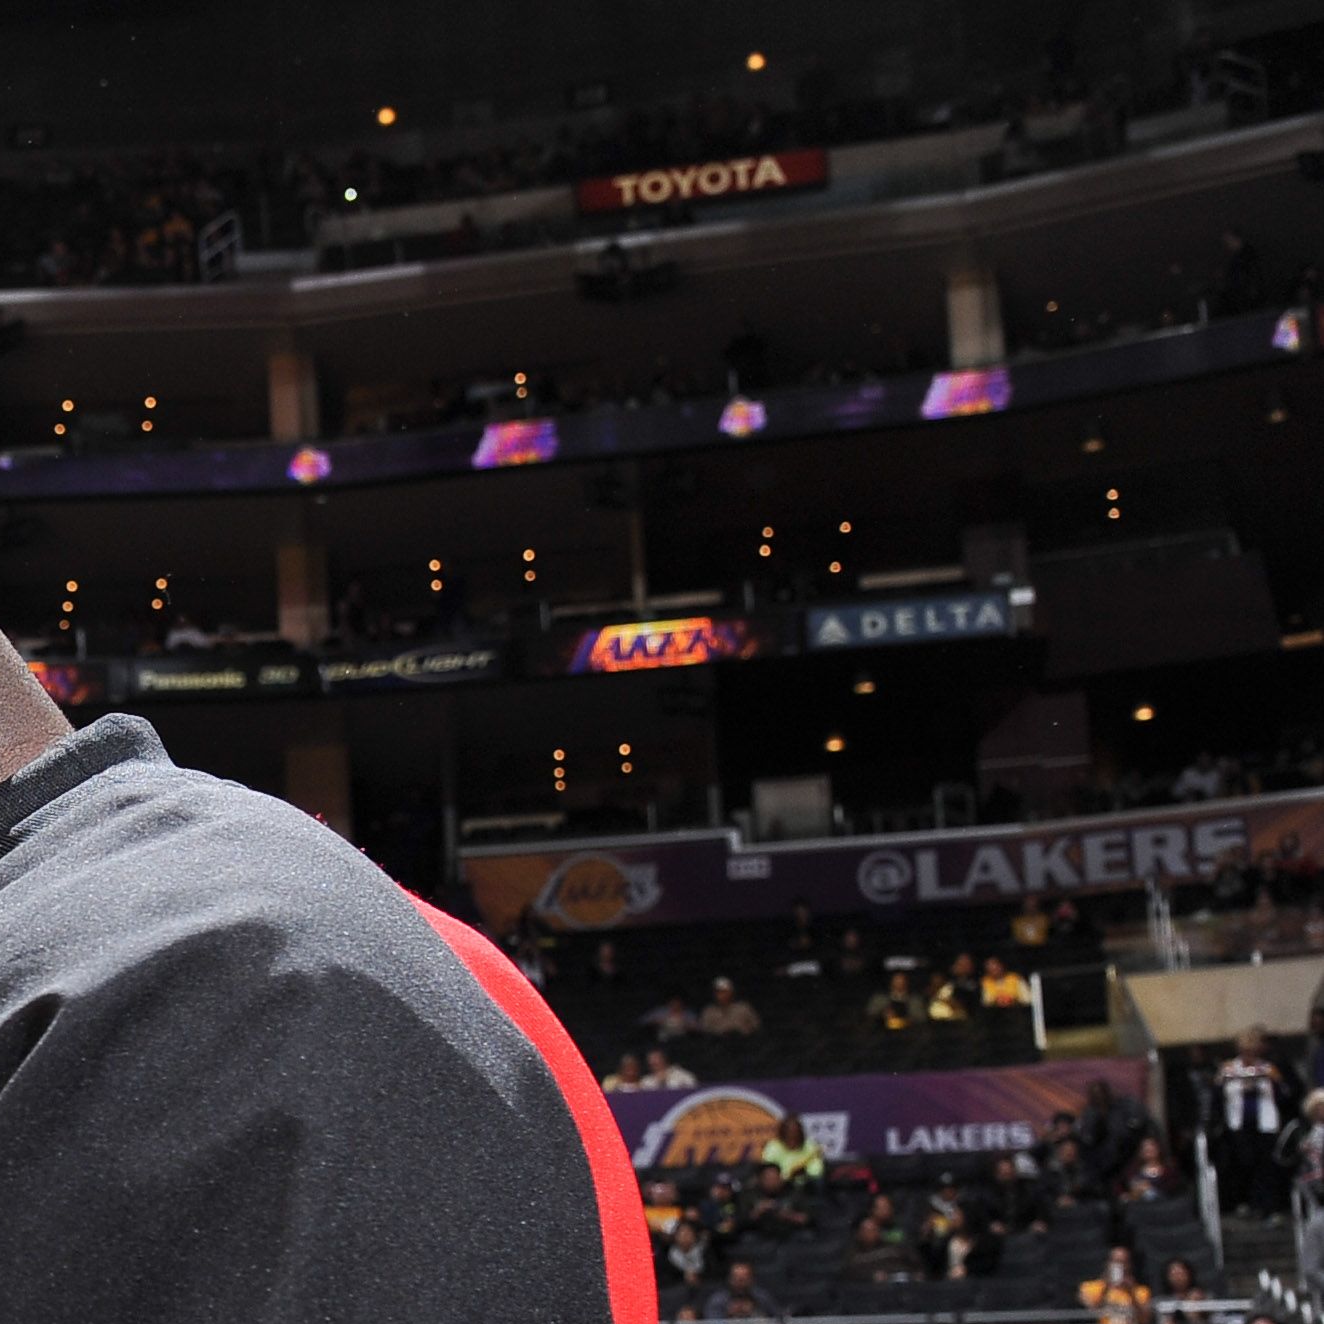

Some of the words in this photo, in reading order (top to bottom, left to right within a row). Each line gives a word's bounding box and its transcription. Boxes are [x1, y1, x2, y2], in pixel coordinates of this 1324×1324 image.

[613, 155, 787, 207] TOYOTA
[859, 601, 1006, 638] DELTA
[857, 824, 1247, 905] @LAKERS
[887, 1121, 1033, 1154] LAKERS
